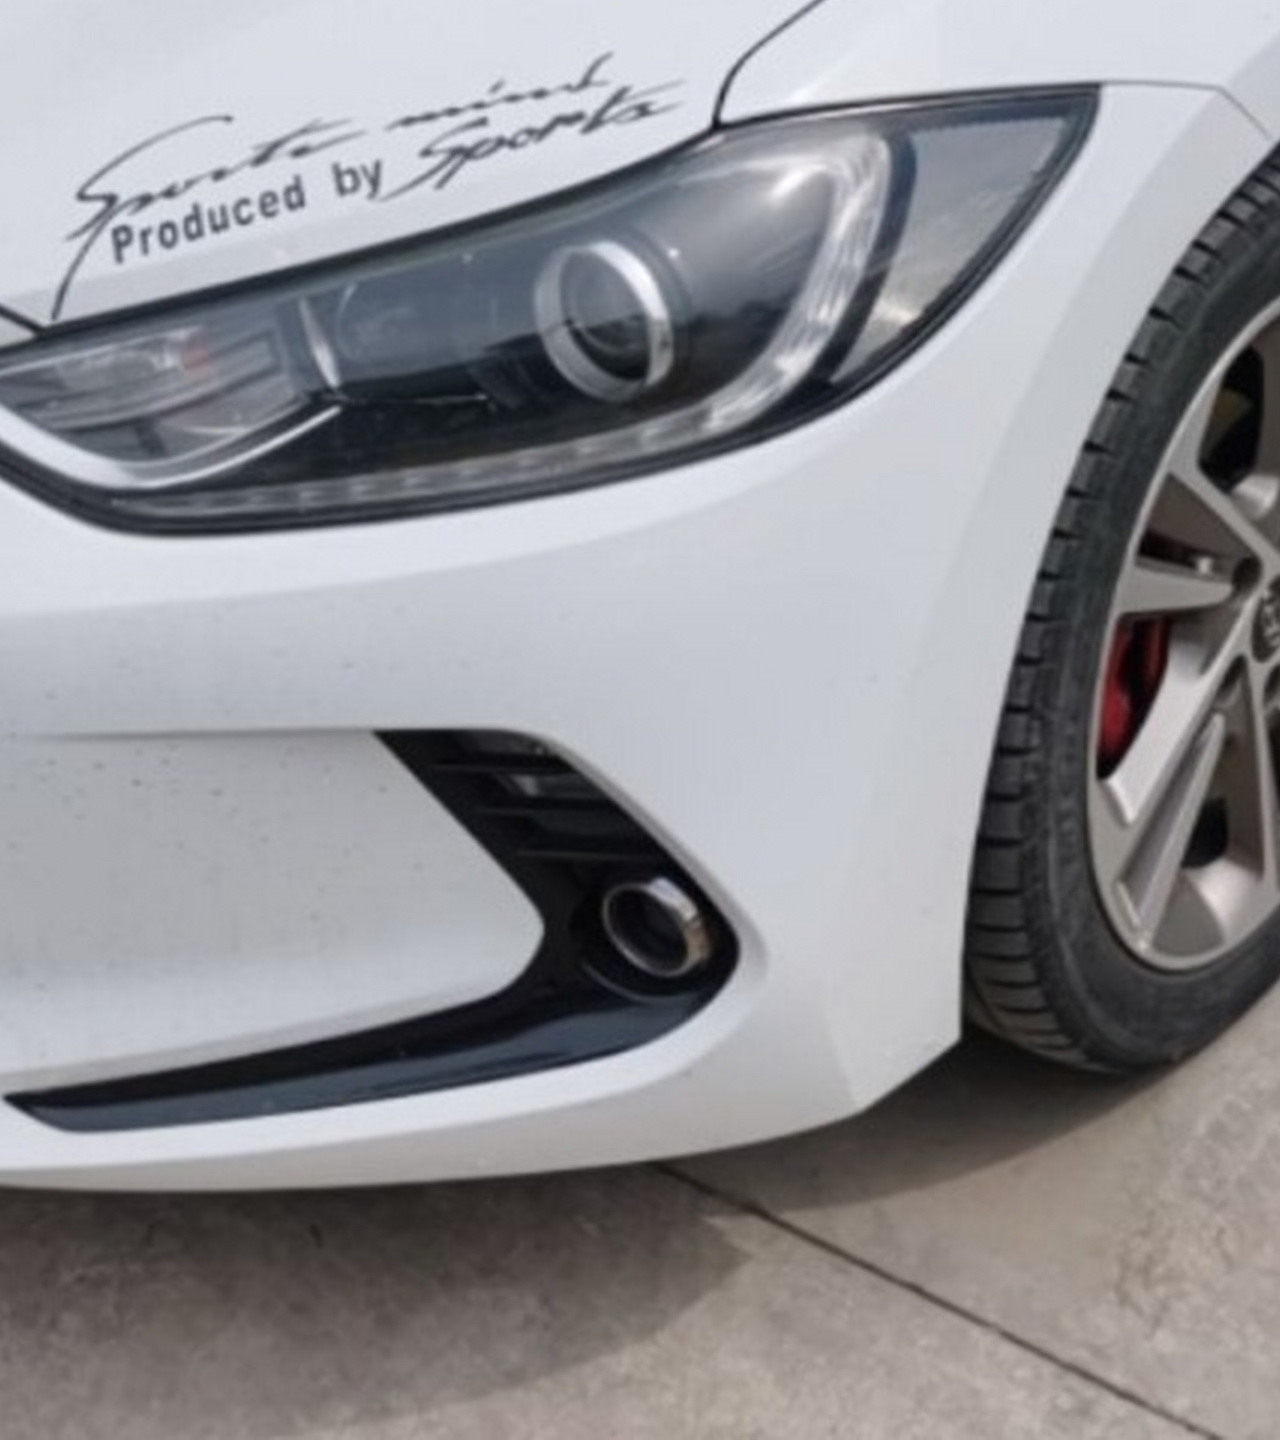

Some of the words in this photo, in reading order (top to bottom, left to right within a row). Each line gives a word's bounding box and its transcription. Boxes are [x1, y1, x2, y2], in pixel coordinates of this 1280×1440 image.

[110, 174, 307, 264] Produced
[331, 156, 384, 199] by
[376, 78, 687, 203] Sports
